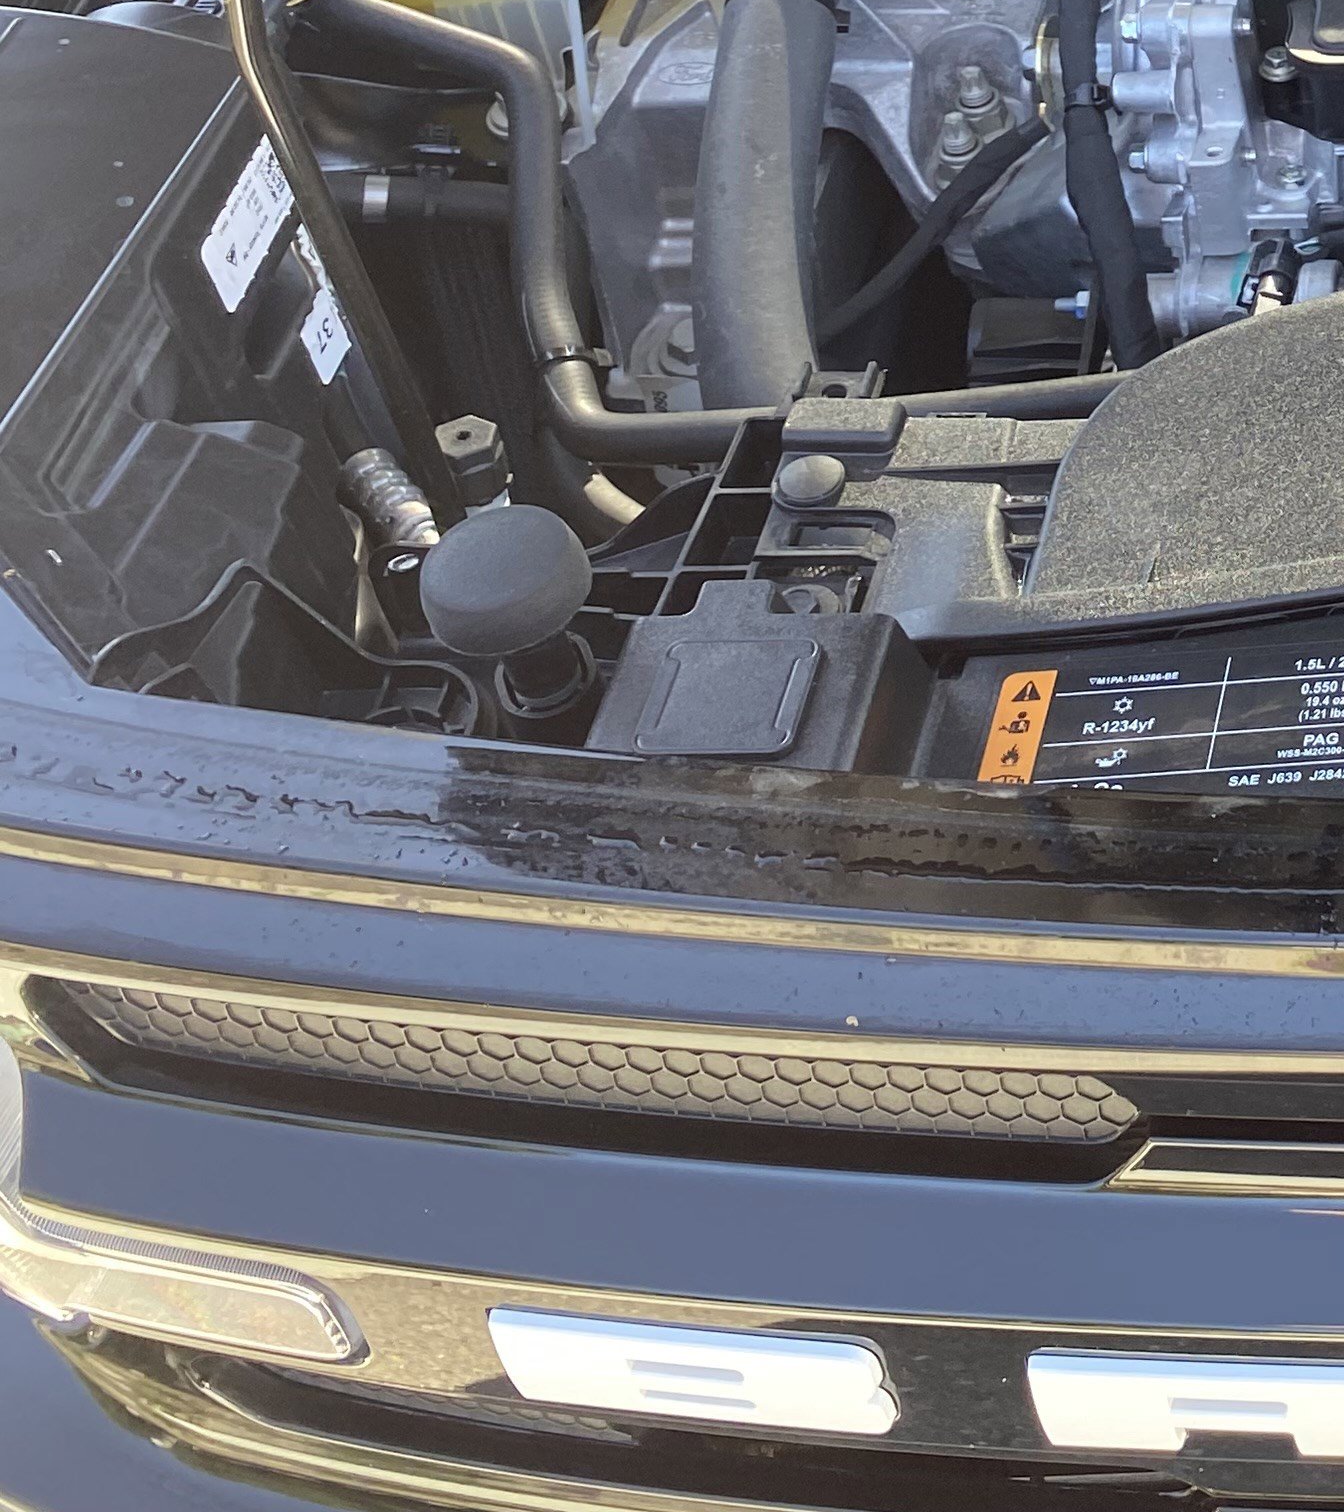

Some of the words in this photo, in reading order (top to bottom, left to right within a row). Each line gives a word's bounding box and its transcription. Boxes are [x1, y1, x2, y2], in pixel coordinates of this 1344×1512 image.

[1294, 659, 1326, 672] 1.5L
[1300, 680, 1338, 695] 0.550
[1305, 696, 1329, 707] 19.4
[1298, 708, 1327, 723] (1.21
[1082, 717, 1156, 735] R-1234yf
[1303, 732, 1340, 747] PAG
[1228, 774, 1261, 787] SAE
[1267, 771, 1303, 785] J639
